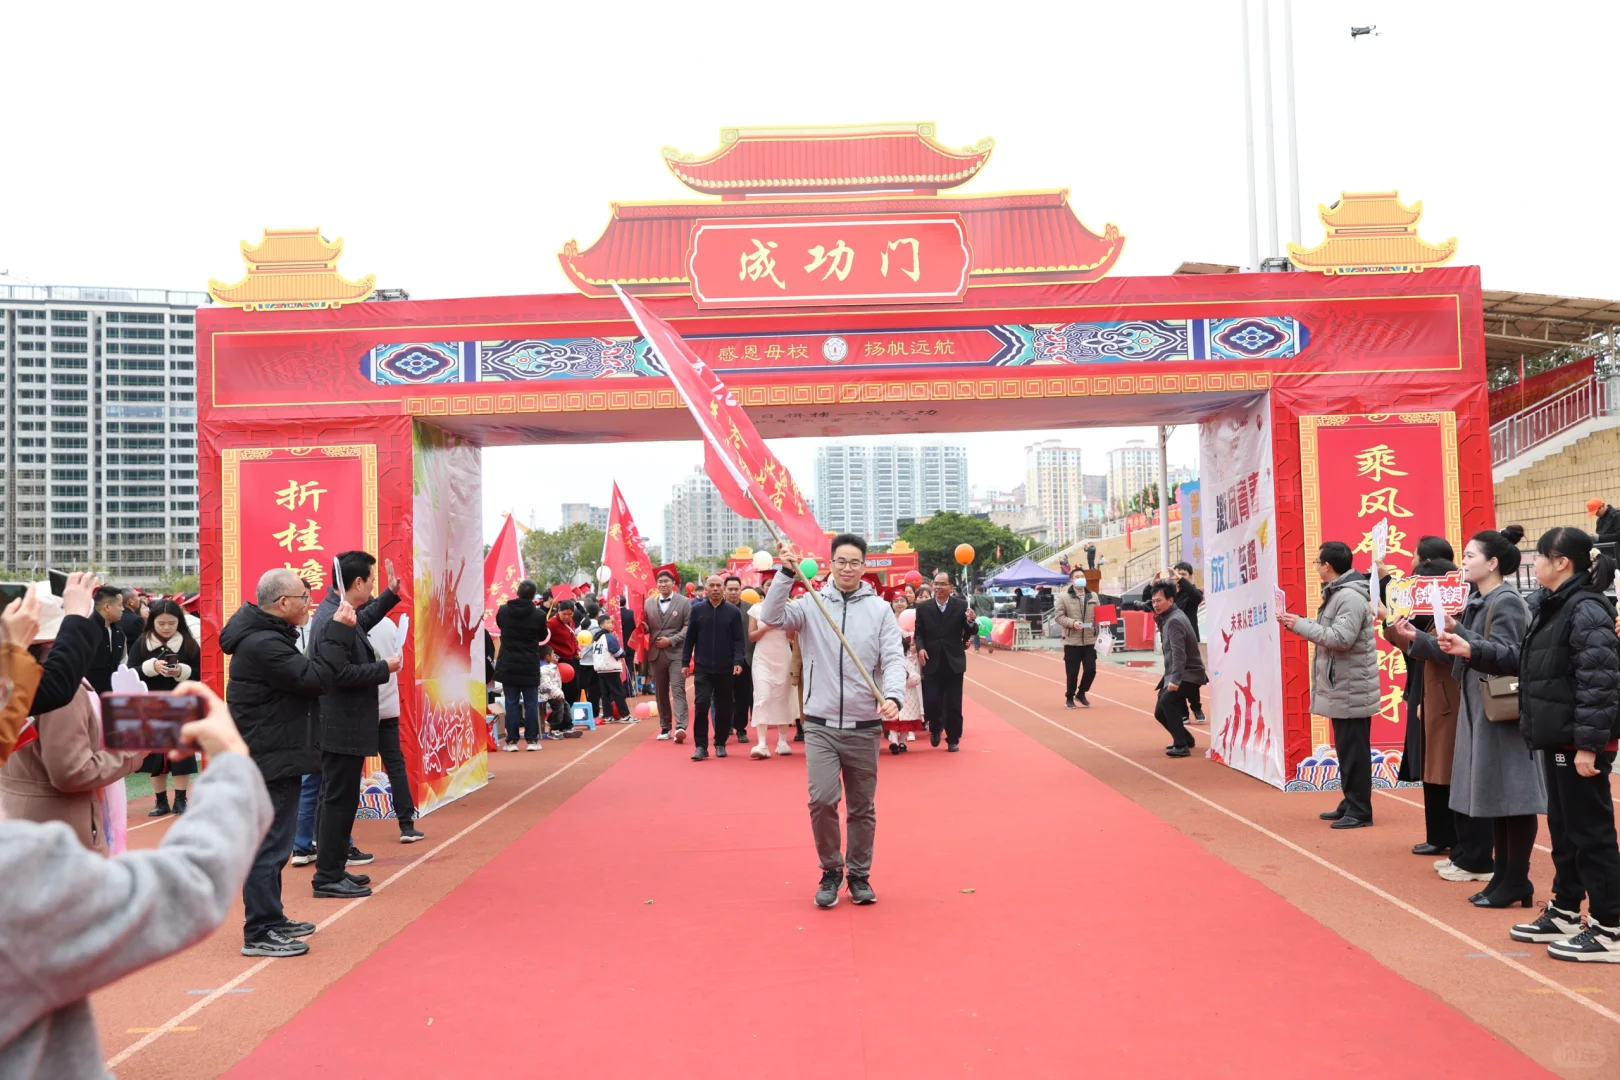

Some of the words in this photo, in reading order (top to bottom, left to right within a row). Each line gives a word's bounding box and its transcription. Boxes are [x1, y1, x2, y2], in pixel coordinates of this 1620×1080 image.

[739, 237, 921, 289] 成功门
[717, 344, 809, 362] 感恩母校
[864, 339, 955, 357] 扬帆远航
[1415, 587, 1462, 603] 奋斗变命运
